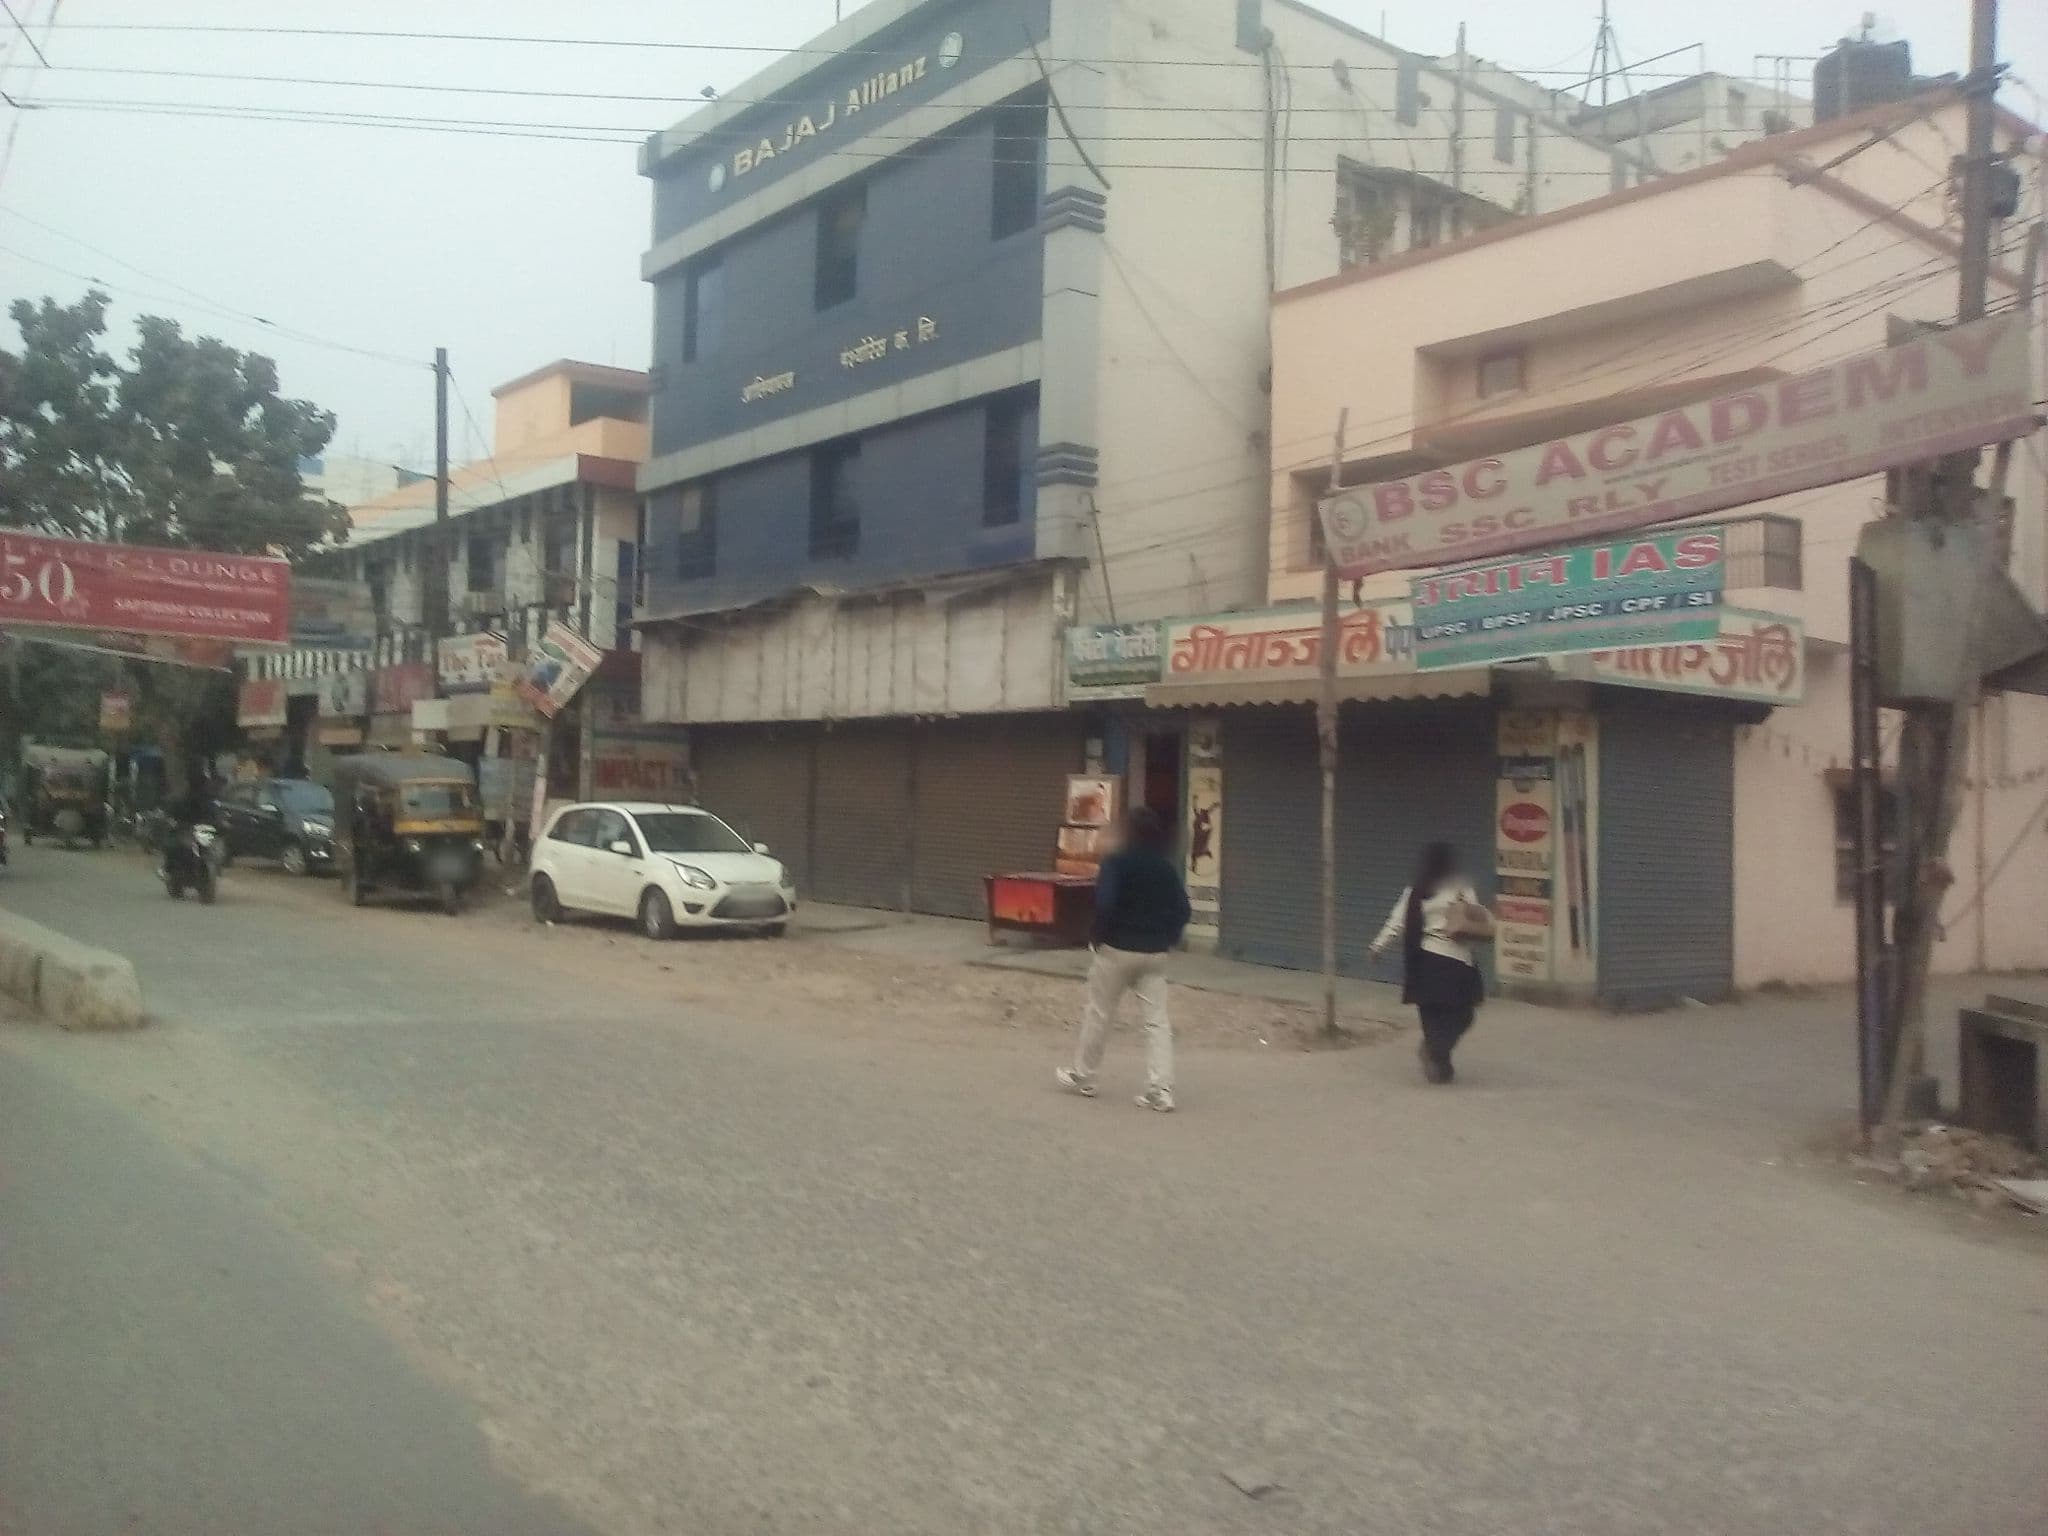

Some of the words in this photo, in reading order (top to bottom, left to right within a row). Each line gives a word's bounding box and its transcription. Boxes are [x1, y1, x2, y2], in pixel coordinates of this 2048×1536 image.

[734, 101, 836, 176] BAJAJ
[846, 56, 927, 116] Allianz
[1373, 458, 1508, 522] BSC
[1536, 321, 2007, 486] ACADEMY
[1340, 532, 1411, 564] BANK
[1440, 506, 1536, 545] SSC
[1566, 478, 1665, 519] RLY
[1593, 533, 1721, 581] IAS
[1548, 603, 1603, 621] JPSC
